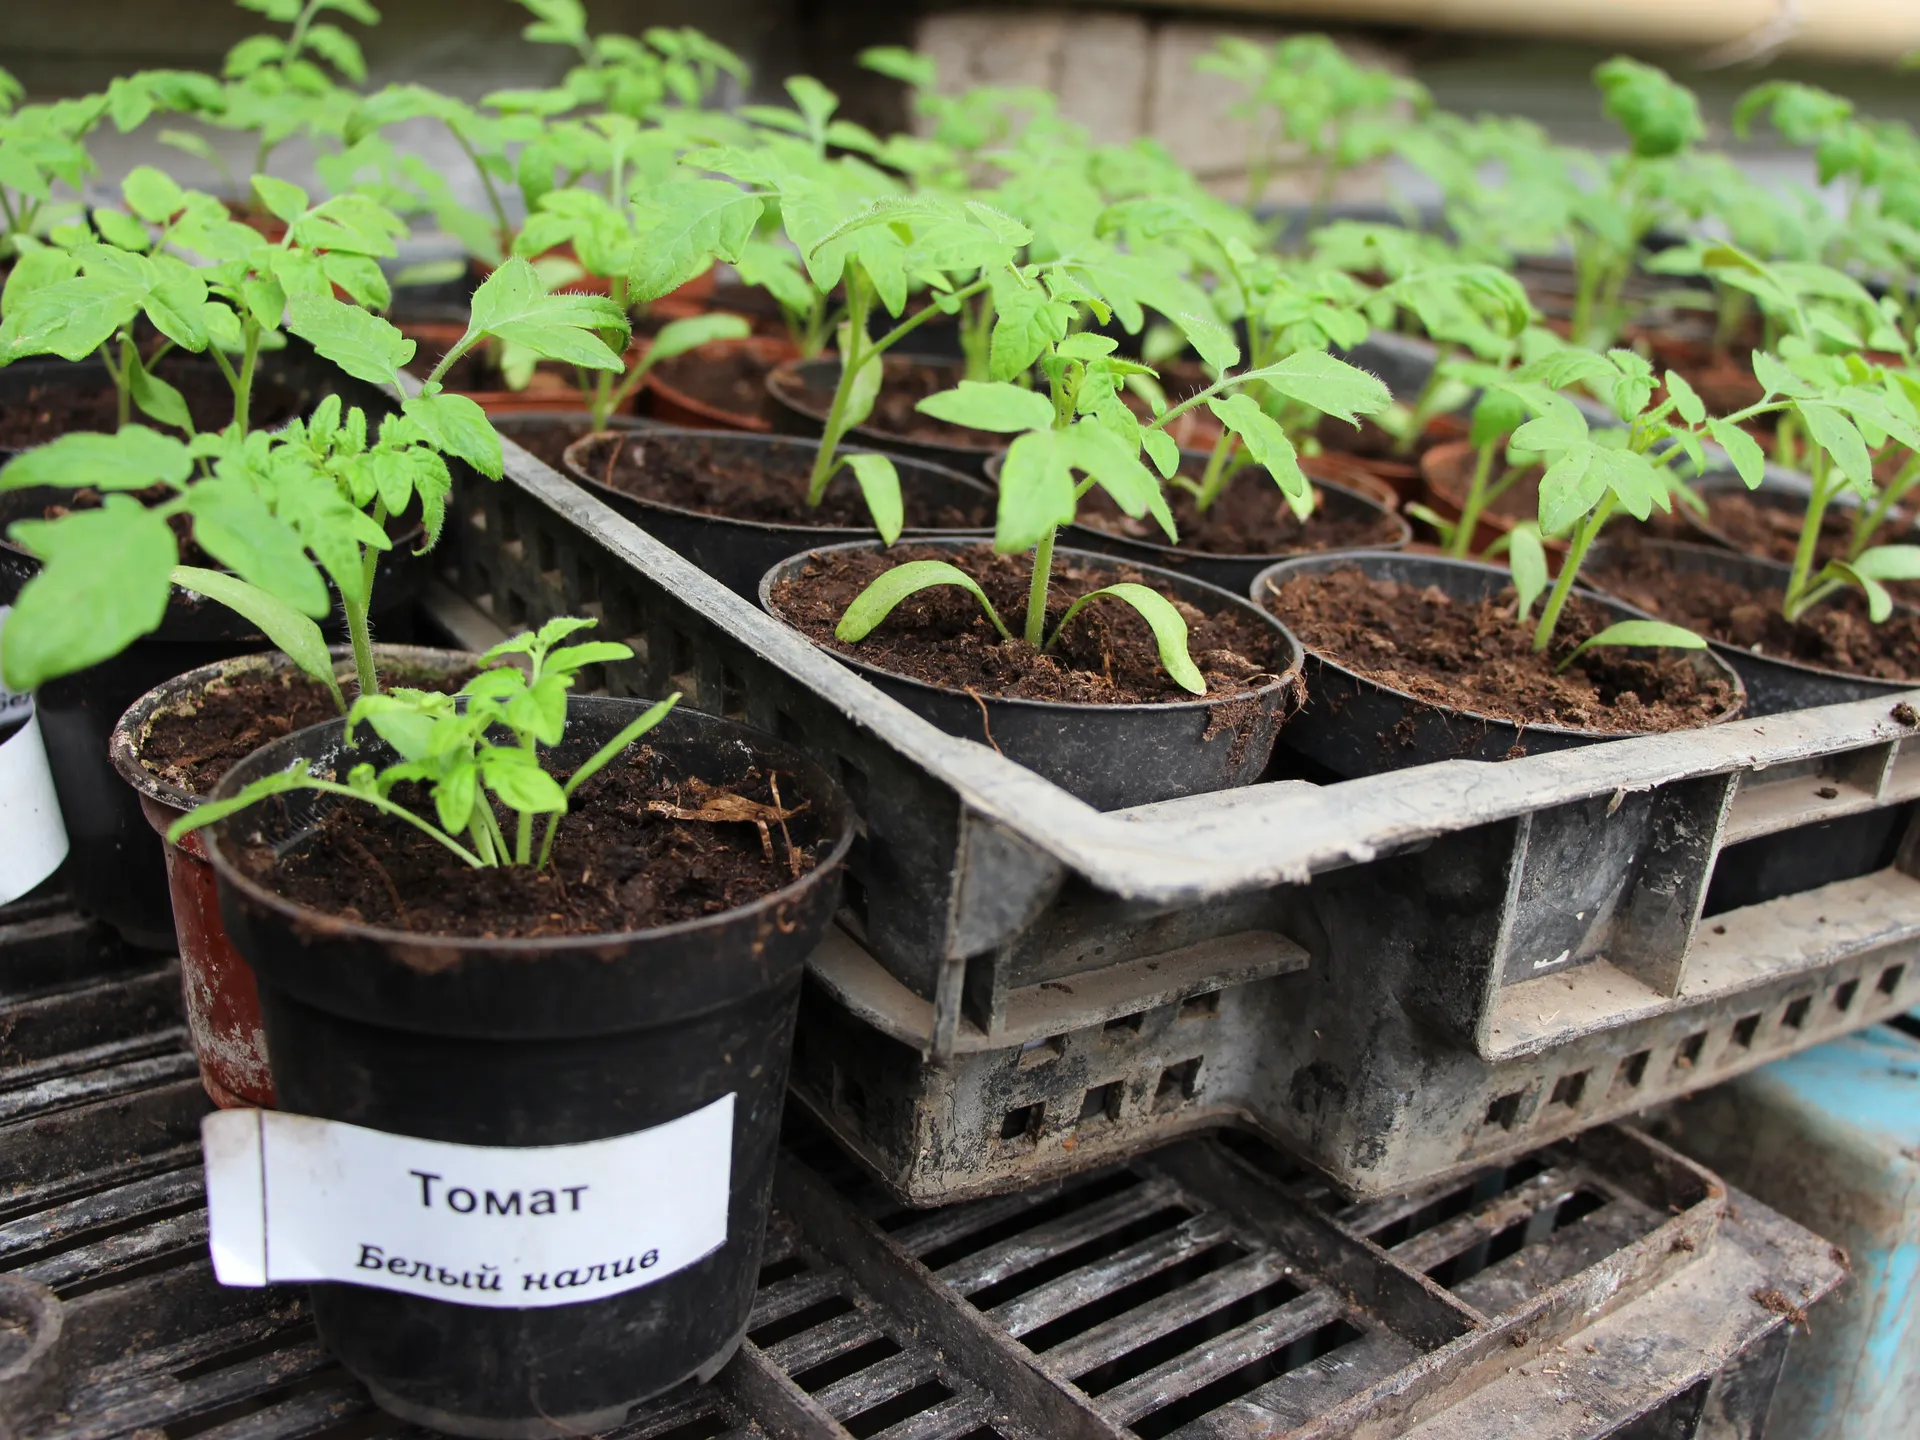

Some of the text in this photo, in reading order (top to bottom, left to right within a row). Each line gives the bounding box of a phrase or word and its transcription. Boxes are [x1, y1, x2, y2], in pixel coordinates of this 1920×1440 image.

[409, 1169, 589, 1216] Томат
[356, 1243, 660, 1291] Белый налив
